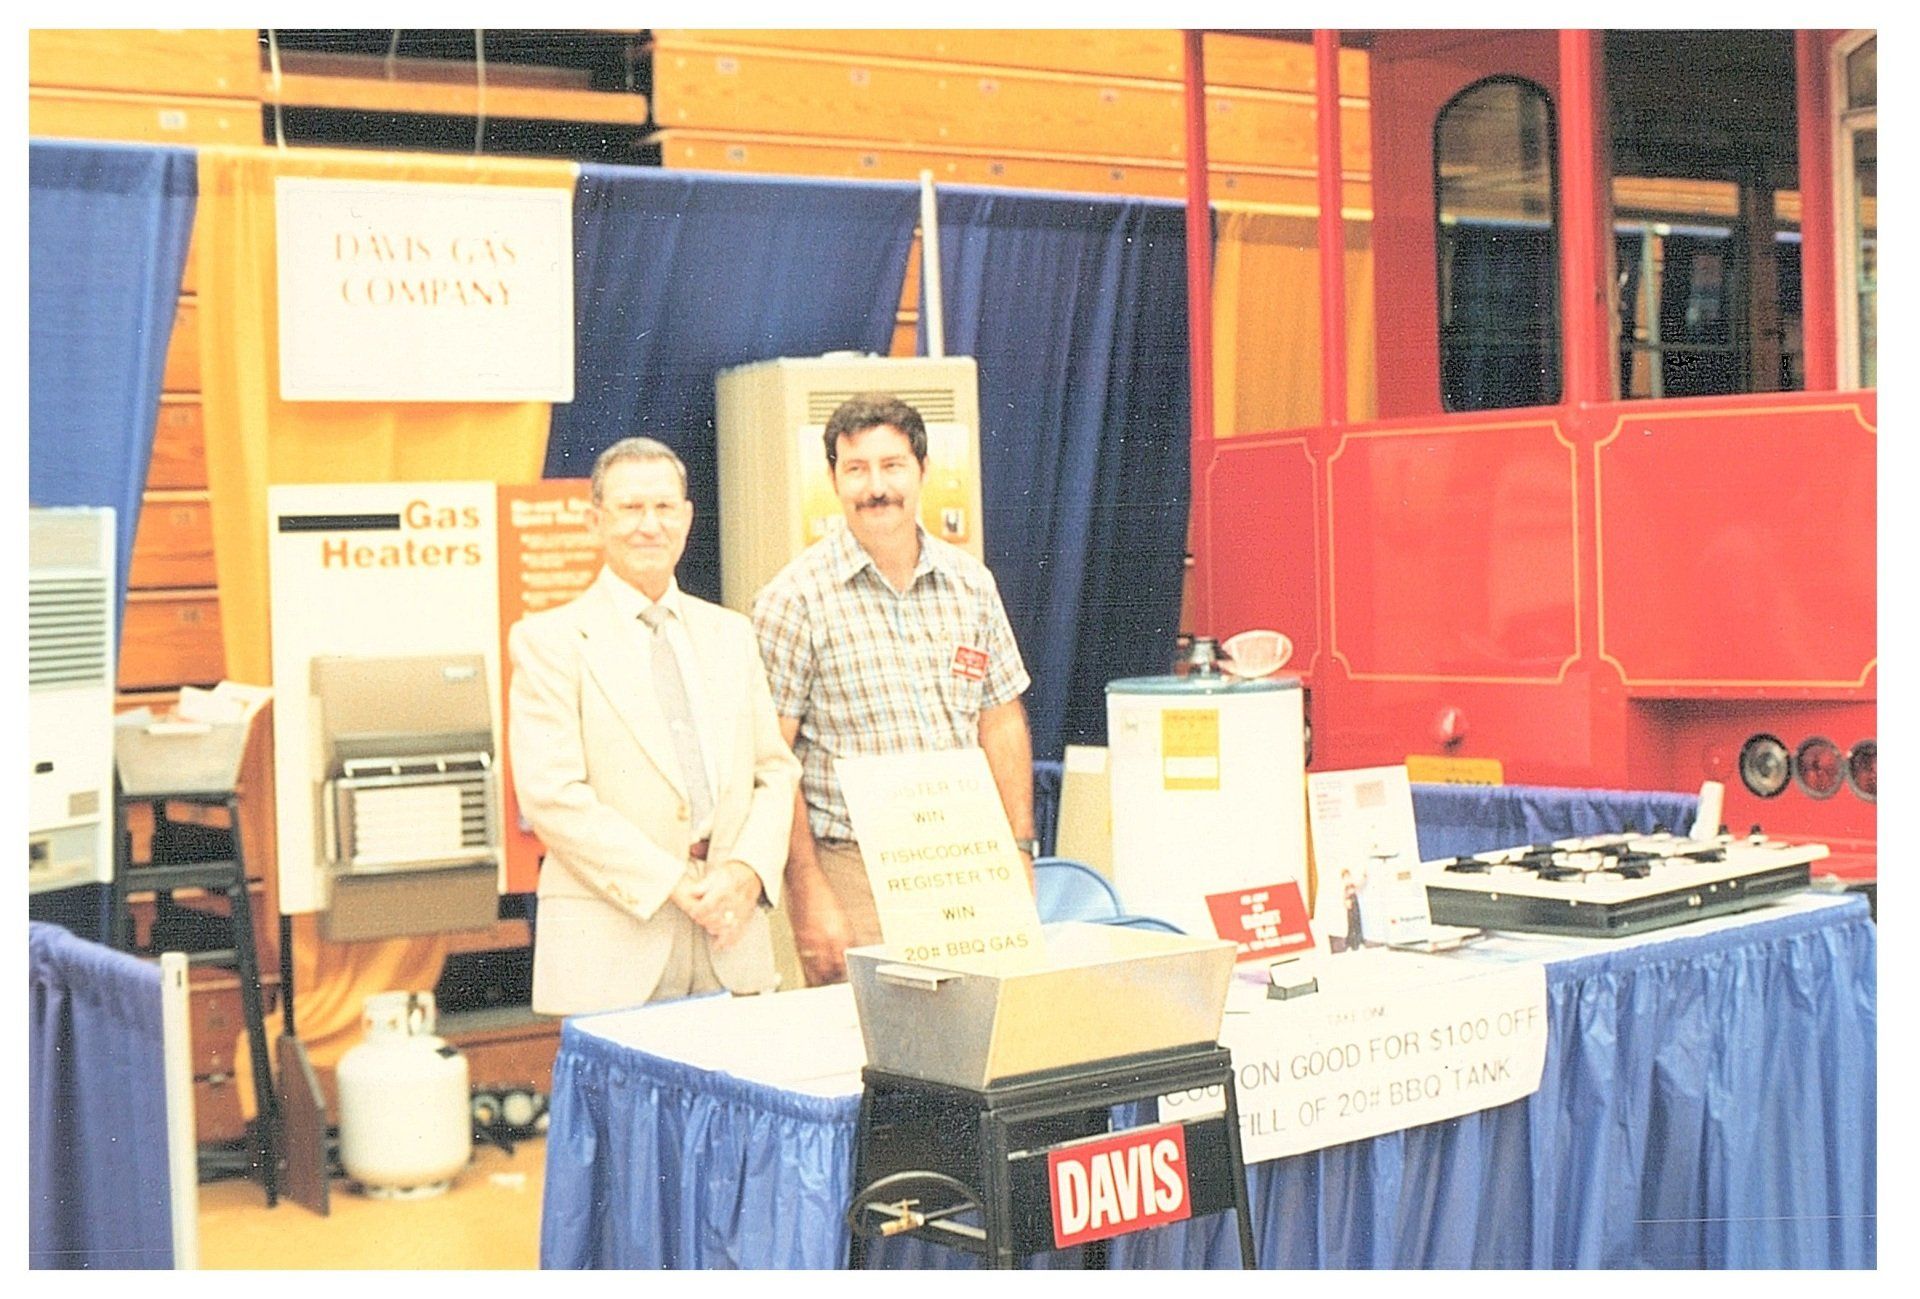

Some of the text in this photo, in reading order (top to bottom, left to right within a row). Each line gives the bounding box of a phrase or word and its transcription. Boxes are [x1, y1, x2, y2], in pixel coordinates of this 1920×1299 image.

[336, 233, 517, 264] DAVIS GAS
[341, 278, 509, 306] COMPANY
[404, 499, 480, 530] Gas
[322, 538, 482, 569] Heaters
[913, 809, 946, 824] WIN
[879, 839, 999, 865] FISHCOOKER
[887, 866, 1011, 893] REGISTER TO
[942, 905, 976, 921] WIN
[905, 932, 1030, 962] 20# BBQ GAS
[1291, 1043, 1361, 1080] GOOD
[1370, 1031, 1420, 1064] FOR
[1498, 1005, 1540, 1037] OFF
[1299, 1097, 1328, 1127] OF
[1338, 1086, 1380, 1117] 20#
[1390, 1073, 1441, 1106] BBQ
[1451, 1057, 1512, 1091] TANK
[1056, 1138, 1184, 1236] DAVIS
